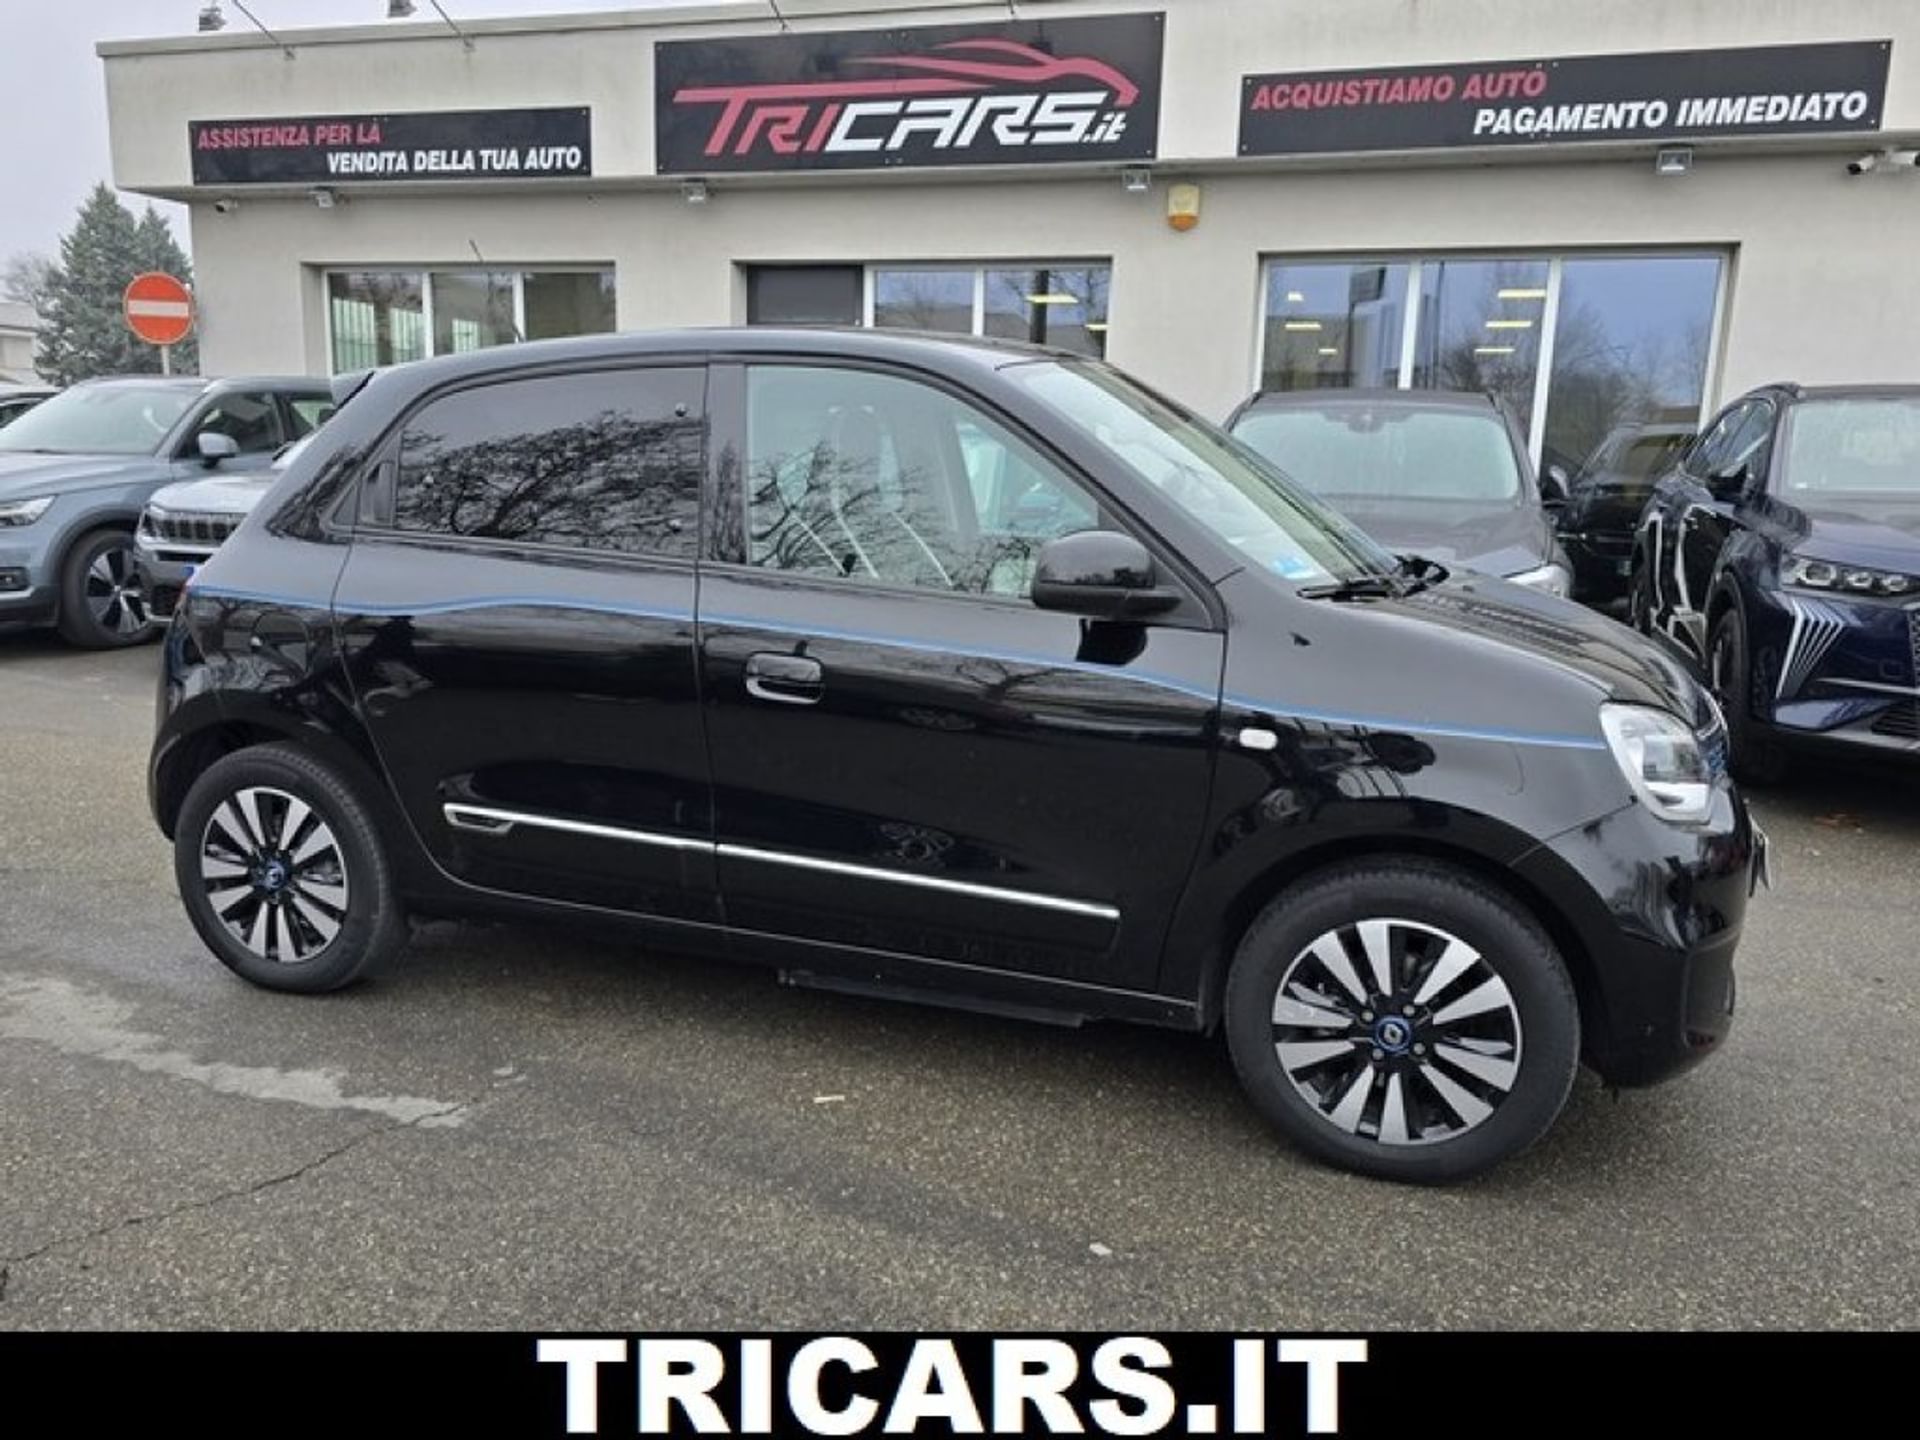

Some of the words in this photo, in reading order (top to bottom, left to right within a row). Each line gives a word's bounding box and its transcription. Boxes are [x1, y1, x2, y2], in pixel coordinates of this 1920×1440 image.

[1251, 74, 1455, 110] ACQUISTIAMO
[1462, 70, 1547, 100] AUTO
[672, 78, 1127, 157] TRICARS.it
[1473, 100, 1667, 135] PAGAMENTO
[1675, 92, 1867, 128] IMMEDIATO
[198, 125, 309, 149] ASSISTENZA
[314, 124, 352, 146] PER
[327, 150, 408, 173] VENDITA
[414, 149, 476, 171] DELLA
[480, 148, 519, 170] TUA
[524, 146, 582, 169] AUTO
